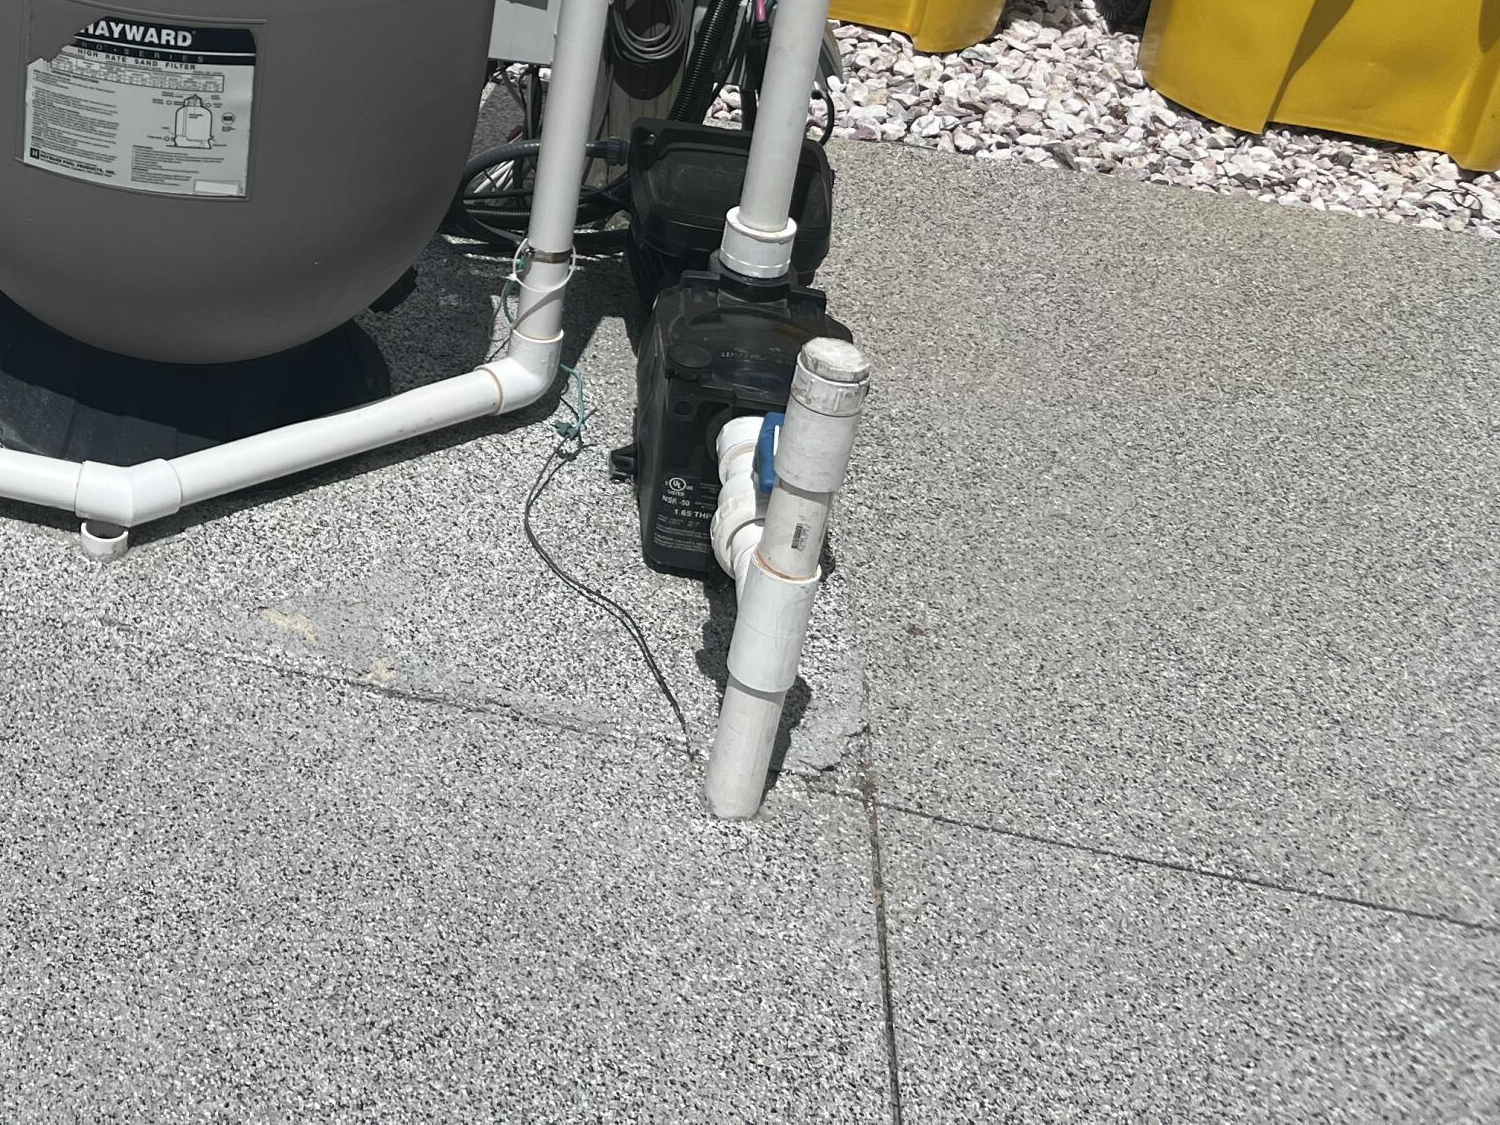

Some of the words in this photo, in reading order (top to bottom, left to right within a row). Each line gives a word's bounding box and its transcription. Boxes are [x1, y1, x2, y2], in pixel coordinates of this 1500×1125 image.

[77, 48, 99, 58] HIGH
[105, 53, 127, 63] RATE
[134, 58, 158, 67] SAND
[165, 62, 196, 70] FILTER
